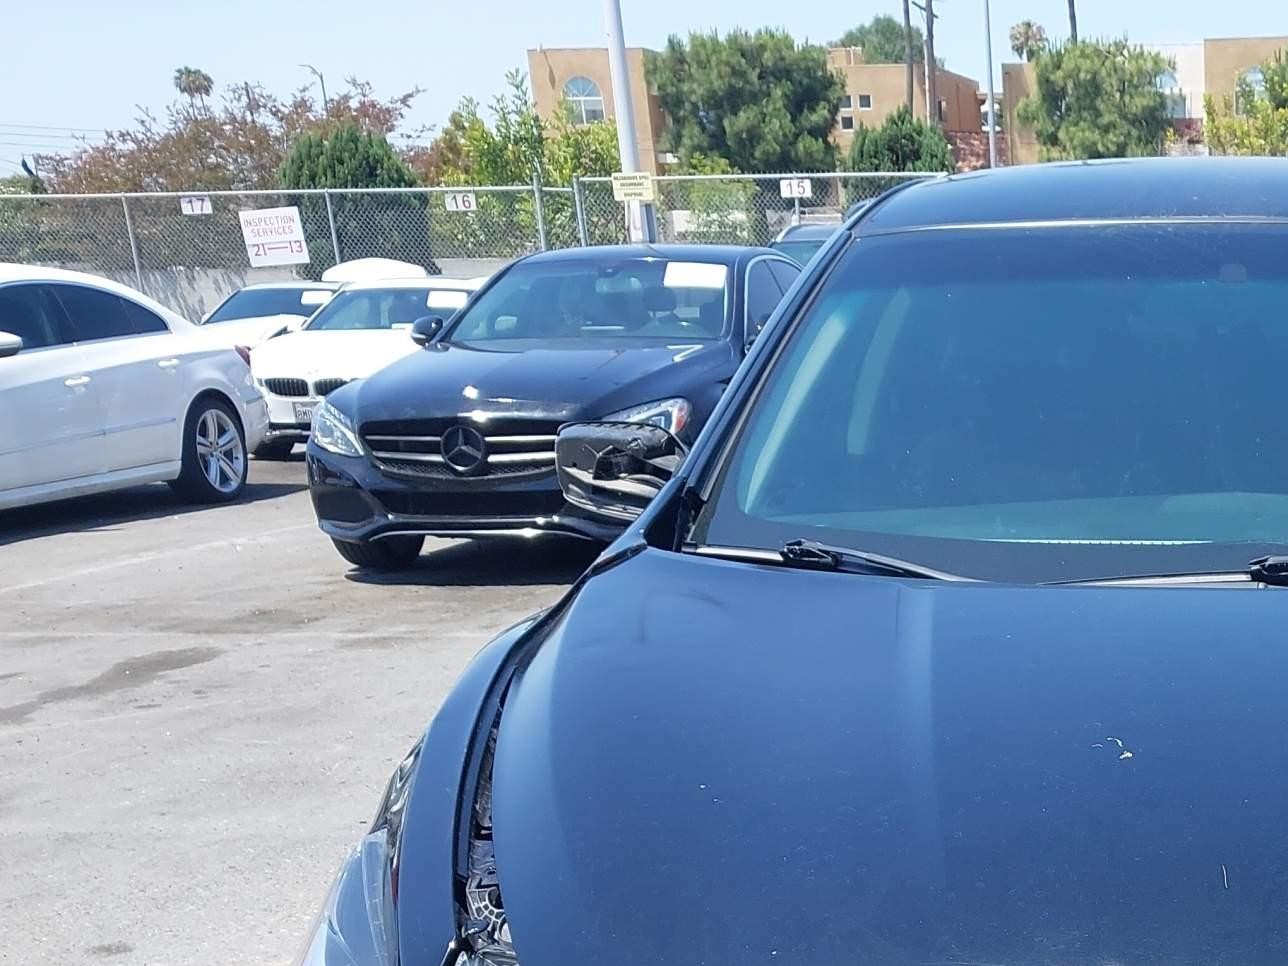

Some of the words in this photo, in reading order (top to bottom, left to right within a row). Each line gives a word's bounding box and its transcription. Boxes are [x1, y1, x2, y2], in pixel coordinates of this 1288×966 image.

[786, 180, 806, 195] 15
[186, 197, 205, 212] 17
[451, 194, 471, 209] 16
[243, 215, 295, 228] INSPECTION
[251, 225, 294, 238] SERVICES
